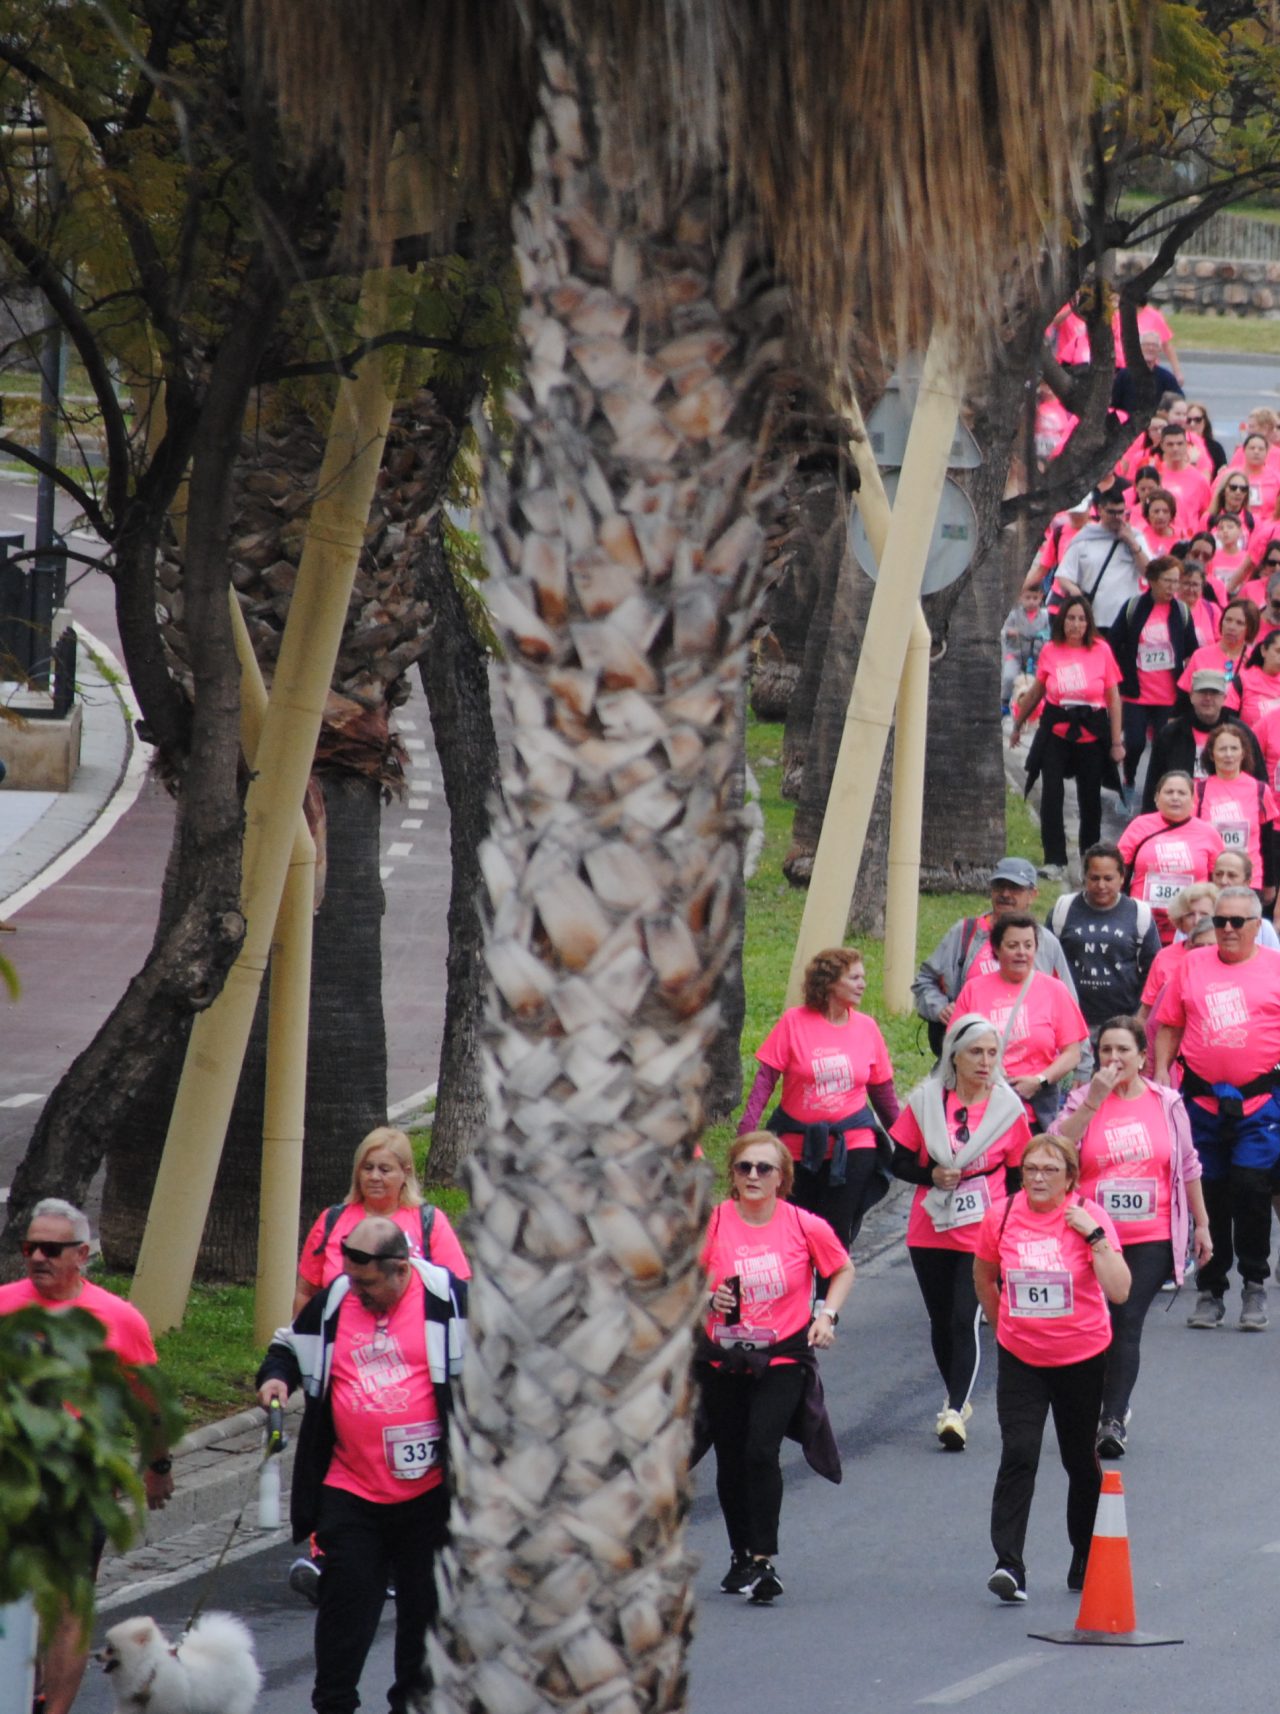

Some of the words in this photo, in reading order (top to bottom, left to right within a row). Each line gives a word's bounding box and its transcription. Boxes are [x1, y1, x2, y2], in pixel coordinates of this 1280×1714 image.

[1145, 652, 1166, 663] 272
[1221, 832, 1240, 844] 06
[1084, 942, 1109, 954] NY
[955, 1194, 977, 1212] 28
[1110, 1194, 1143, 1209] 530
[1028, 1286, 1049, 1304] 61
